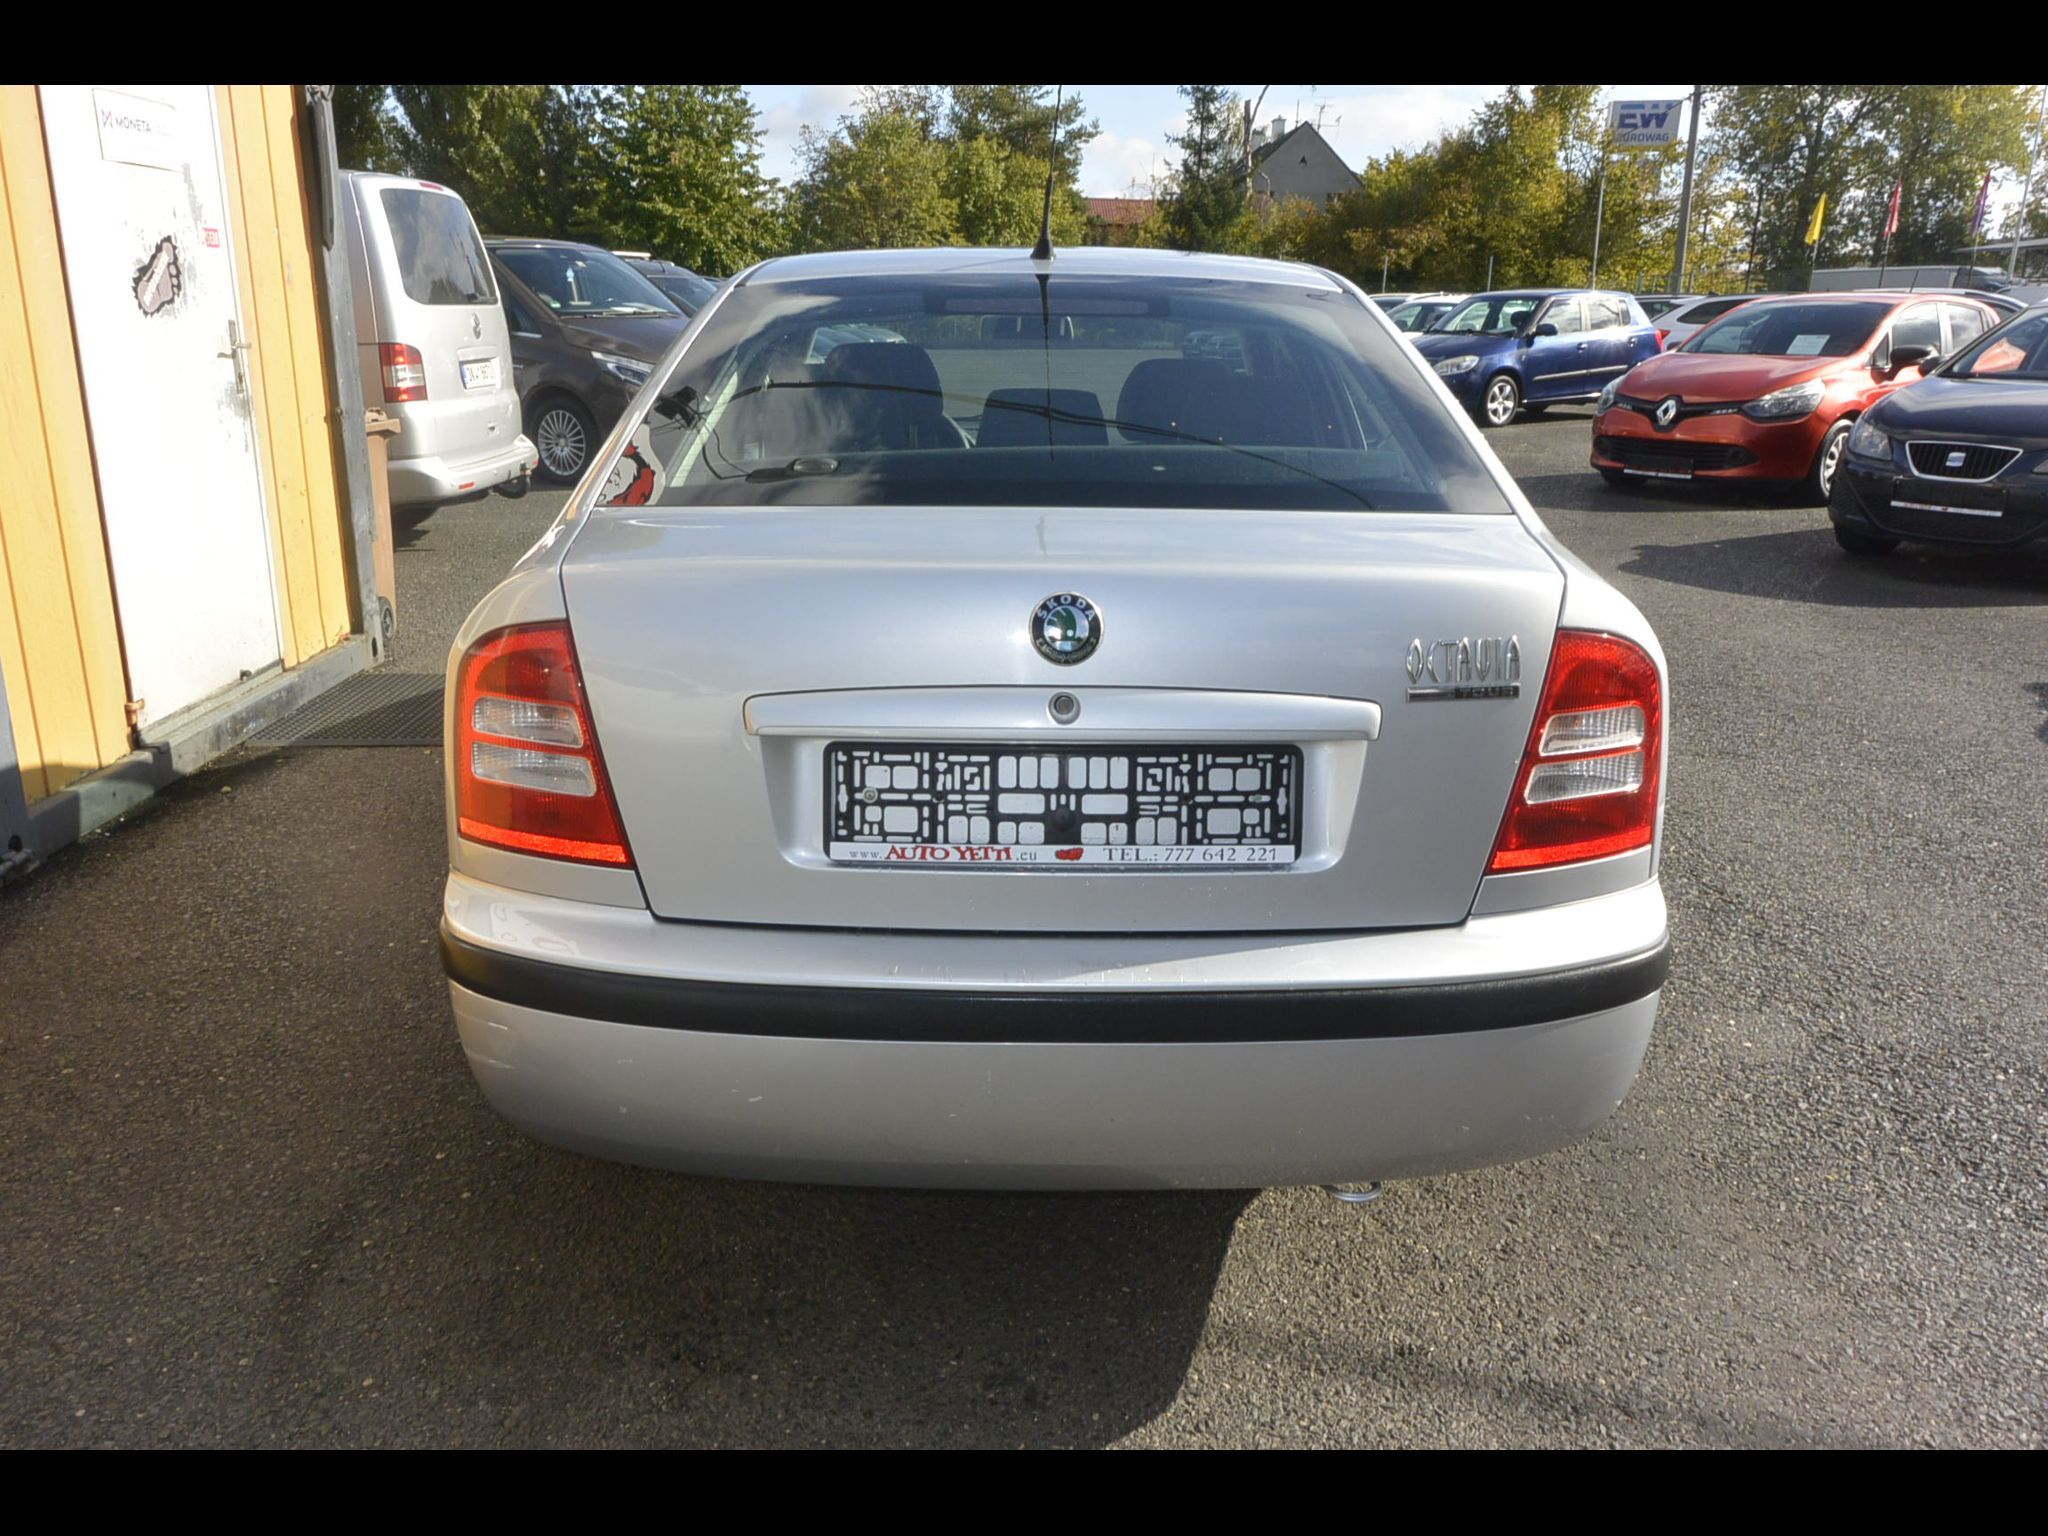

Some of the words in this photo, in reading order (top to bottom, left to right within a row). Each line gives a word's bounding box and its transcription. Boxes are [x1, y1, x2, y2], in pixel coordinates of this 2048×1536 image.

[115, 116, 152, 132] MONETA
[1406, 635, 1521, 684] OCTAVIA
[1102, 847, 1159, 862] TEL.:
[1164, 848, 1196, 862] 777
[1201, 848, 1237, 862] 642
[1246, 848, 1278, 862] 221
